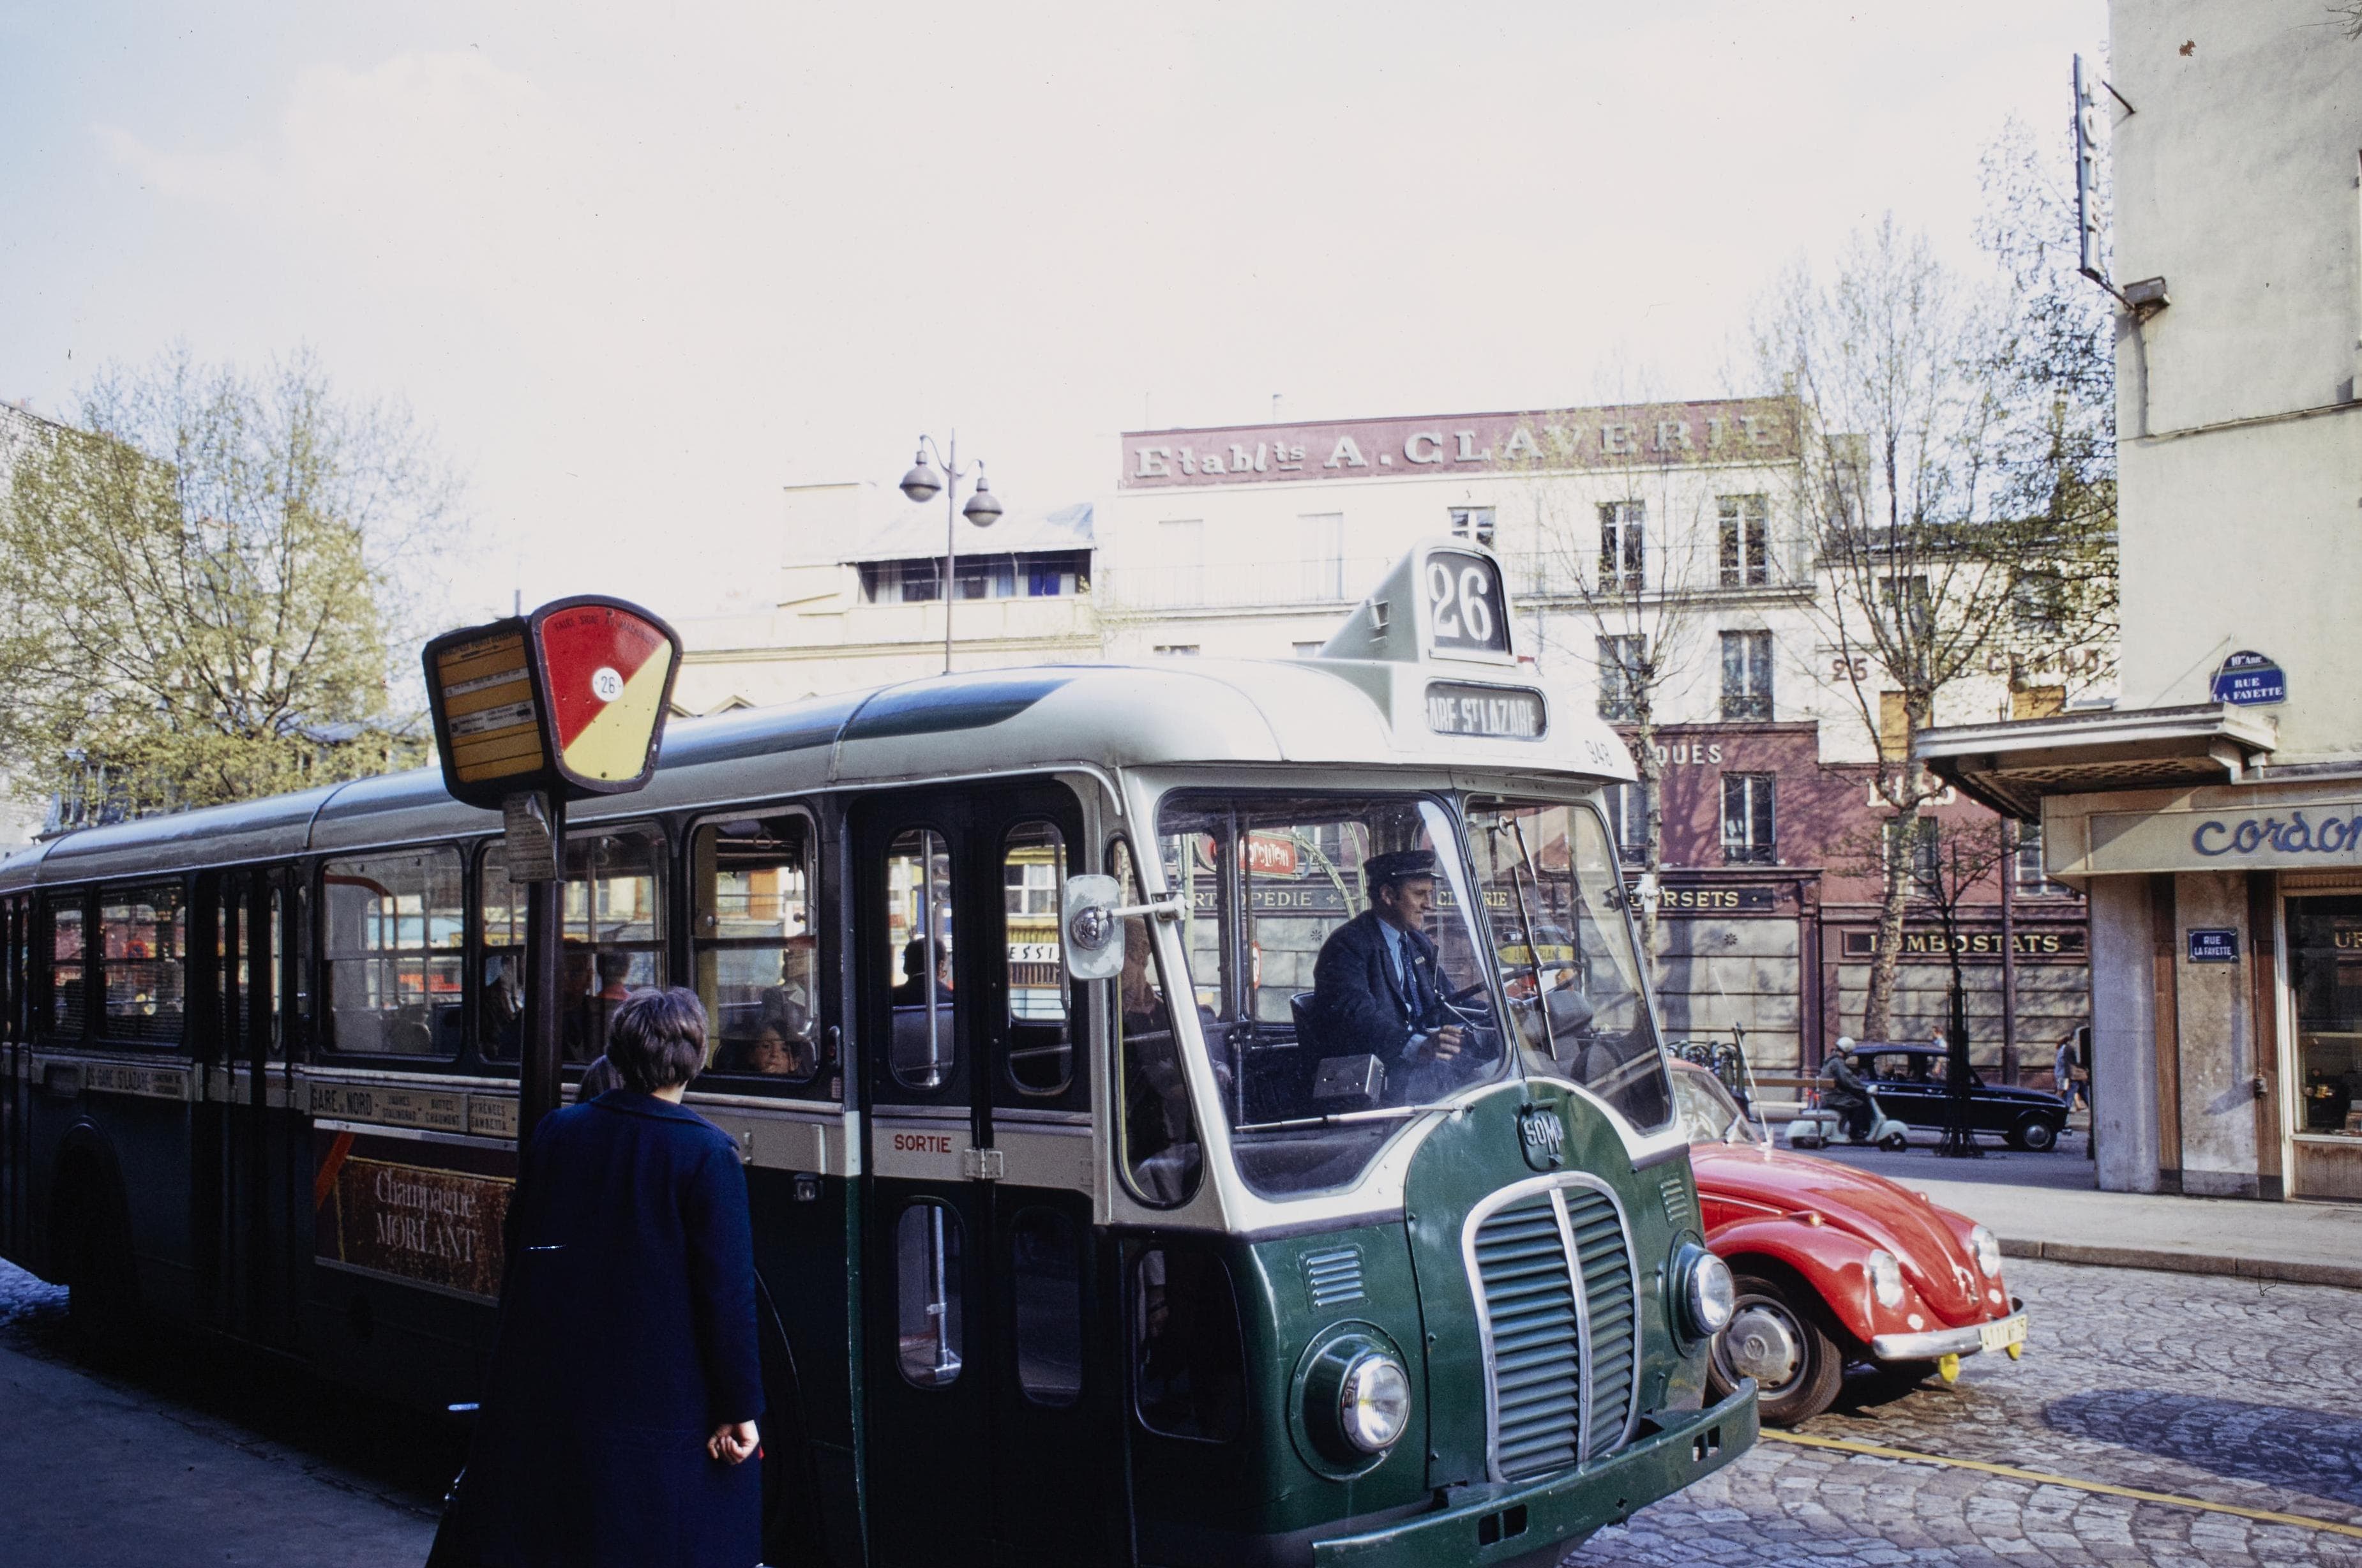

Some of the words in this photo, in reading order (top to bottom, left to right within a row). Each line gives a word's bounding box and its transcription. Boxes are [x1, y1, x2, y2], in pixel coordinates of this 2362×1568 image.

[1403, 414, 1782, 465] CLAVERIE
[1427, 562, 1493, 642] 26
[1832, 658, 1868, 681] 25
[600, 675, 615, 694] 26
[2213, 693, 2229, 702] LA
[2232, 686, 2283, 700] FAYETTE
[2234, 677, 2260, 688] RUE
[1426, 697, 1456, 732] ARE
[2194, 947, 2204, 956] LA
[2204, 946, 2232, 956] FAYETTE
[2203, 935, 2222, 945] RUE
[310, 1088, 338, 1112] GARE
[347, 1091, 372, 1116] NORD
[894, 1134, 952, 1153] SORTIE
[376, 1168, 477, 1225] Champagne
[376, 1212, 478, 1262] MORLANT
